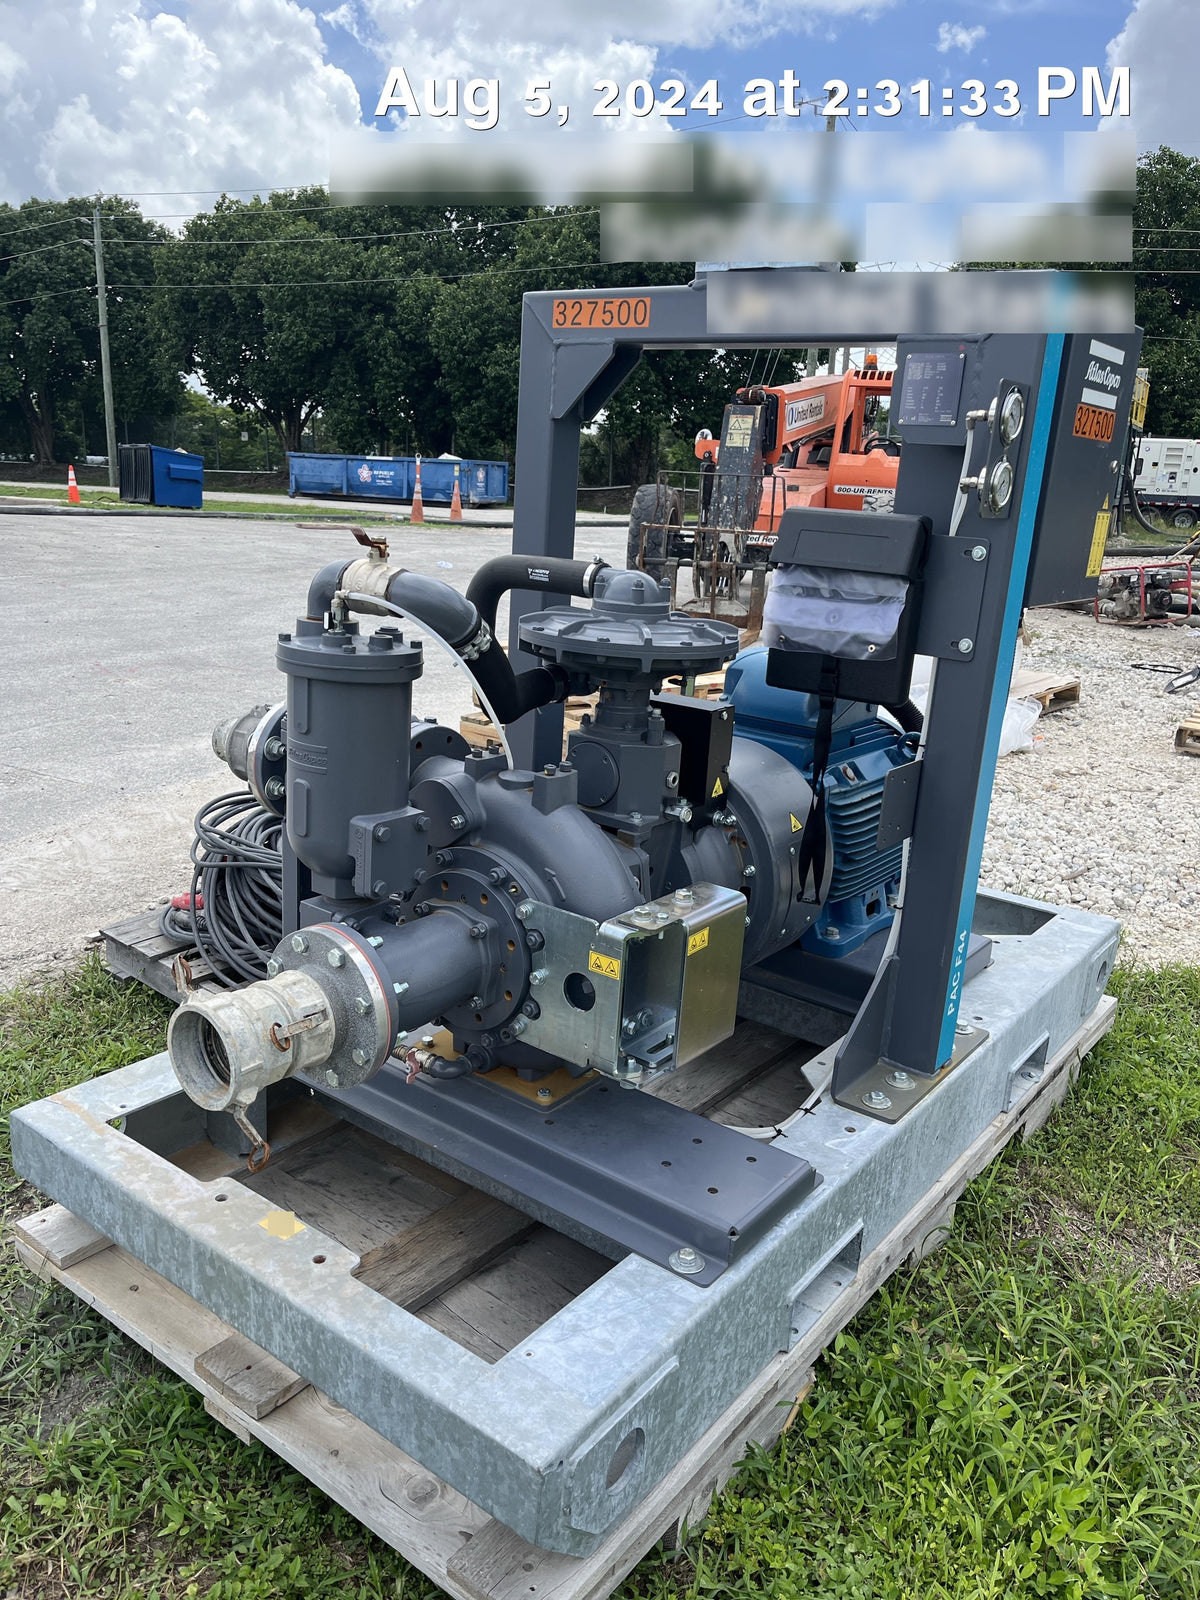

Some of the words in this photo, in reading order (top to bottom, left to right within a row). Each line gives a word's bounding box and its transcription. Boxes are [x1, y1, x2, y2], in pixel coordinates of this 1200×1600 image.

[555, 300, 648, 326] 327500
[1084, 360, 1105, 384] Atlas
[1103, 366, 1122, 391] Copco
[1074, 406, 1115, 441] 327500
[948, 971, 960, 1015] PAC
[955, 929, 967, 967] F44
